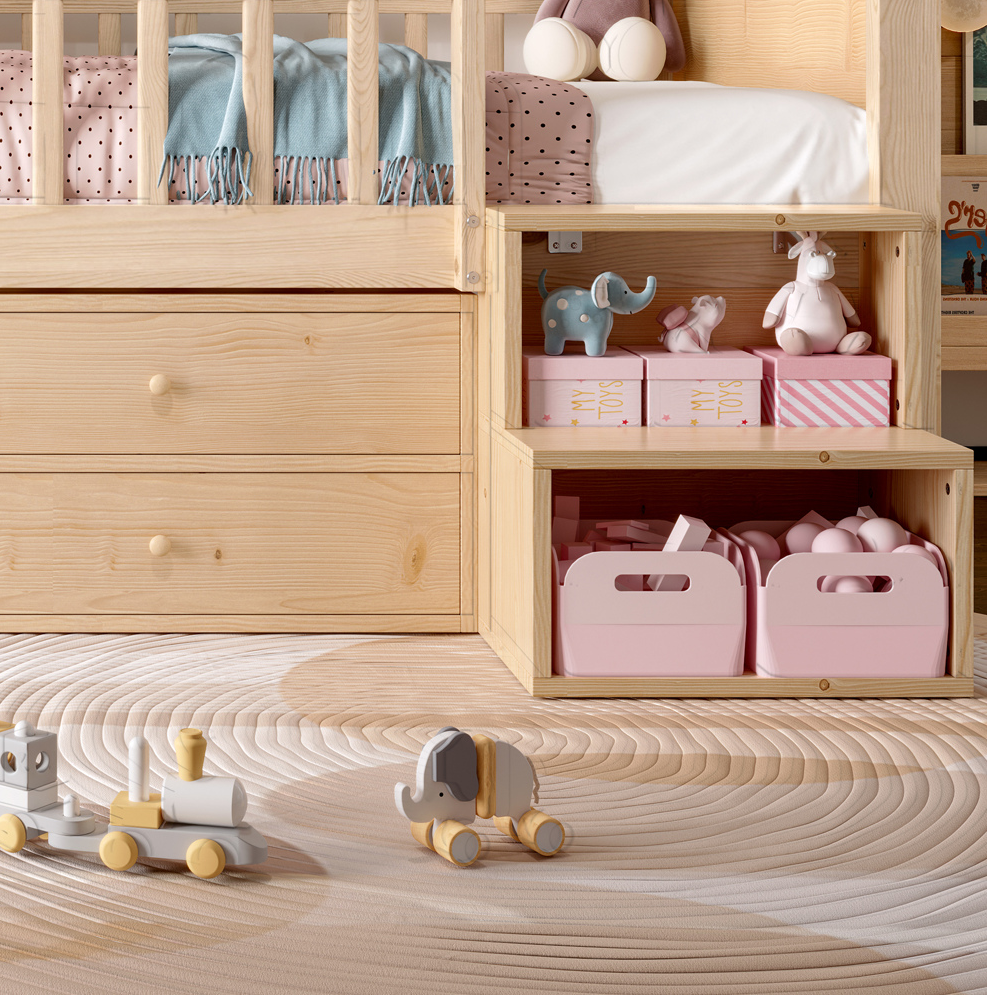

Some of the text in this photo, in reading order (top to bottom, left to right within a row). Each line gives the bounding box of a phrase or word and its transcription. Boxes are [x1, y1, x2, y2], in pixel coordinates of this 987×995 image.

[571, 389, 595, 411] MY
[598, 380, 623, 420] TOYS
[690, 389, 715, 411] MY
[718, 380, 743, 420] TOYS
